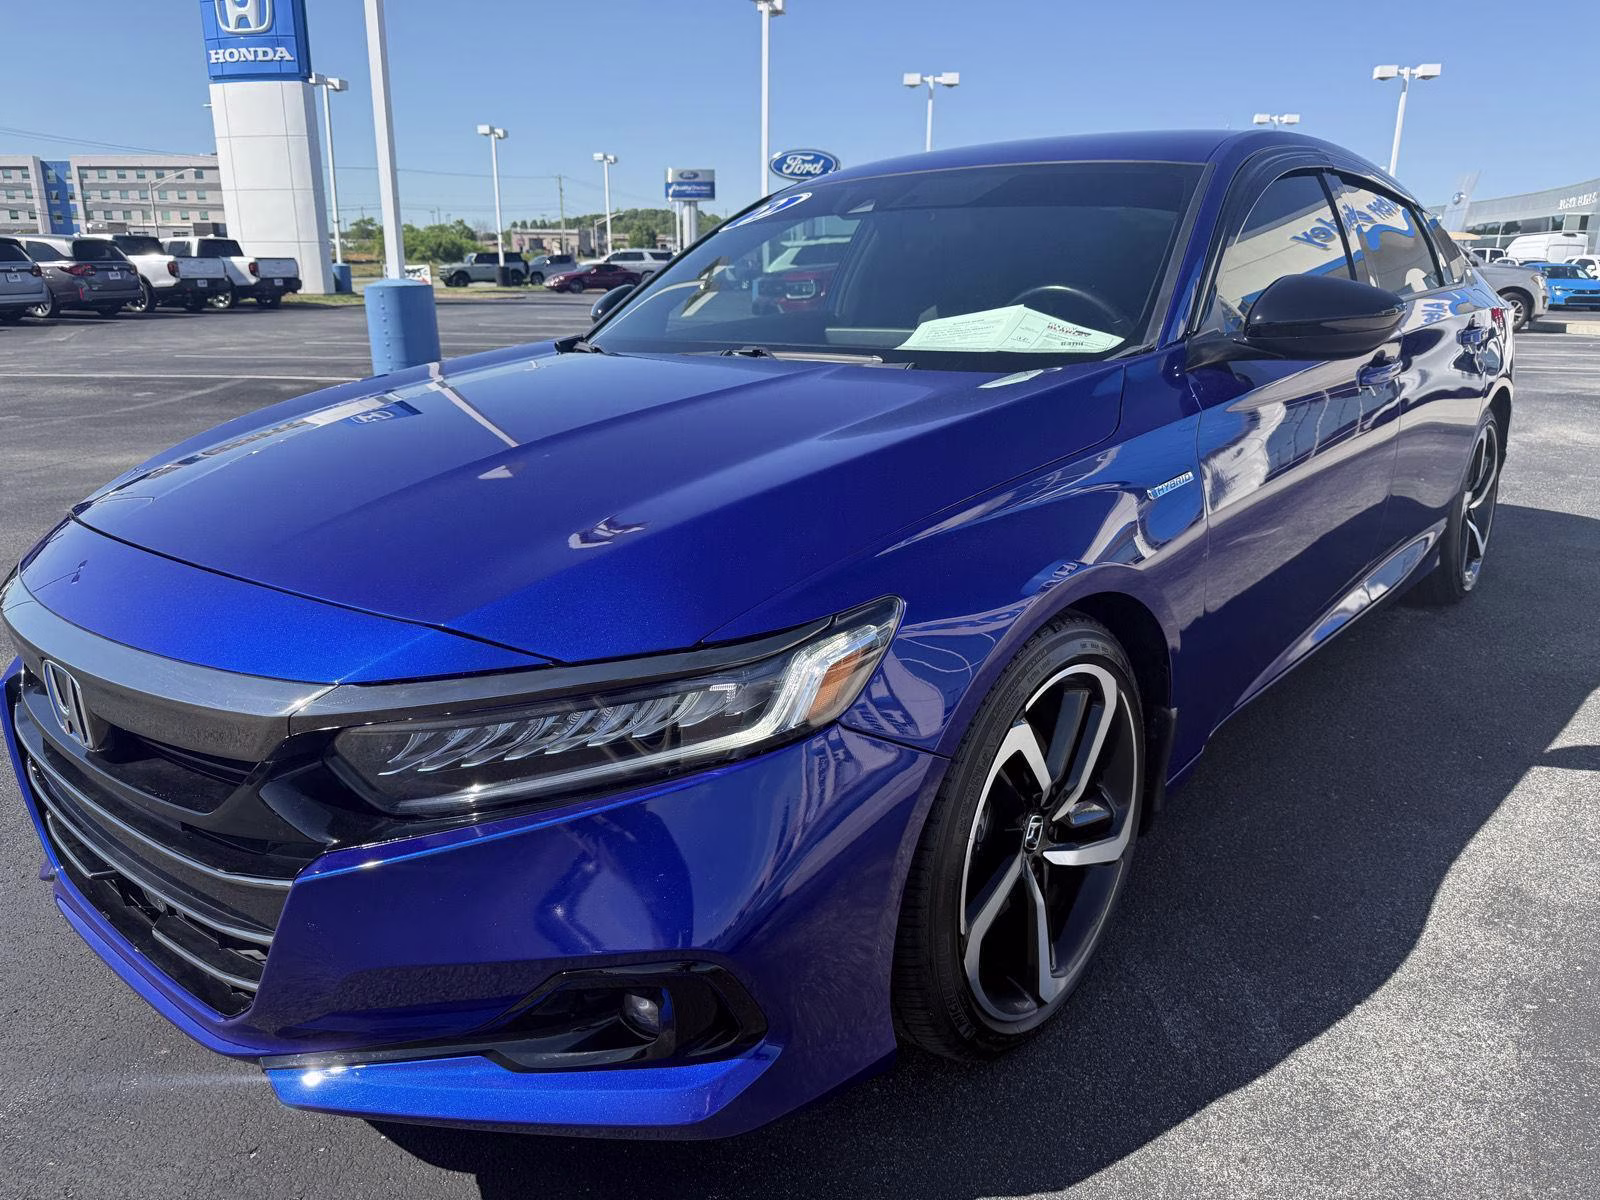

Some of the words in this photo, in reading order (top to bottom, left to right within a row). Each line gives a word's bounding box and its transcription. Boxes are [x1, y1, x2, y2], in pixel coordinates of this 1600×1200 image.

[208, 47, 294, 64] HONDA
[782, 155, 825, 174] Ford
[1156, 472, 1191, 496] HYBRID
